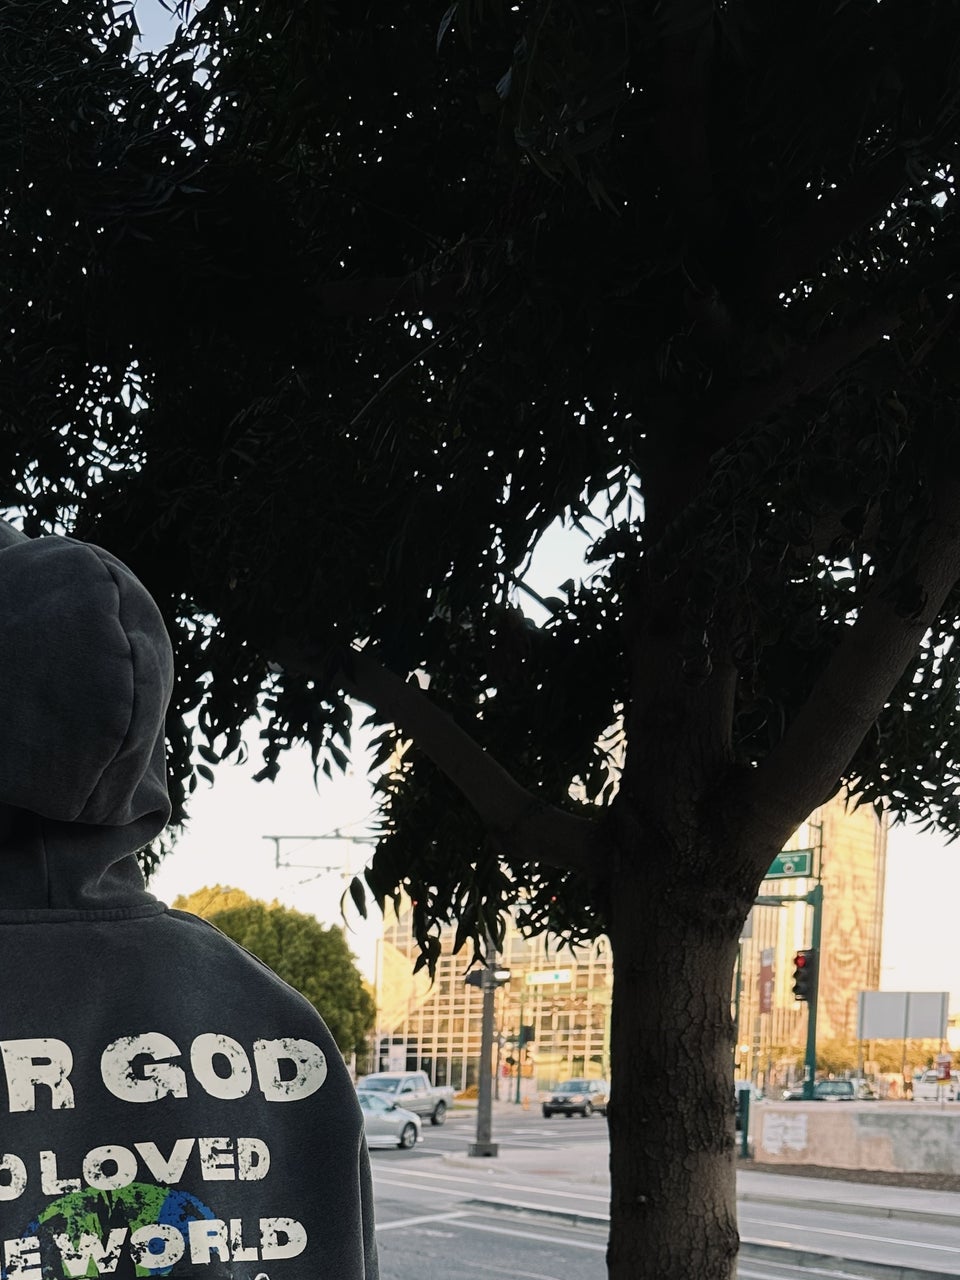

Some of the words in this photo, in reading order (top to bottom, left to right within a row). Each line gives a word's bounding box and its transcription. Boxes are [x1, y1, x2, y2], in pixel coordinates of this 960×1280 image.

[101, 1032, 328, 1102] GOD
[40, 1137, 271, 1195] LOVED
[53, 1217, 308, 1277] WORLD
